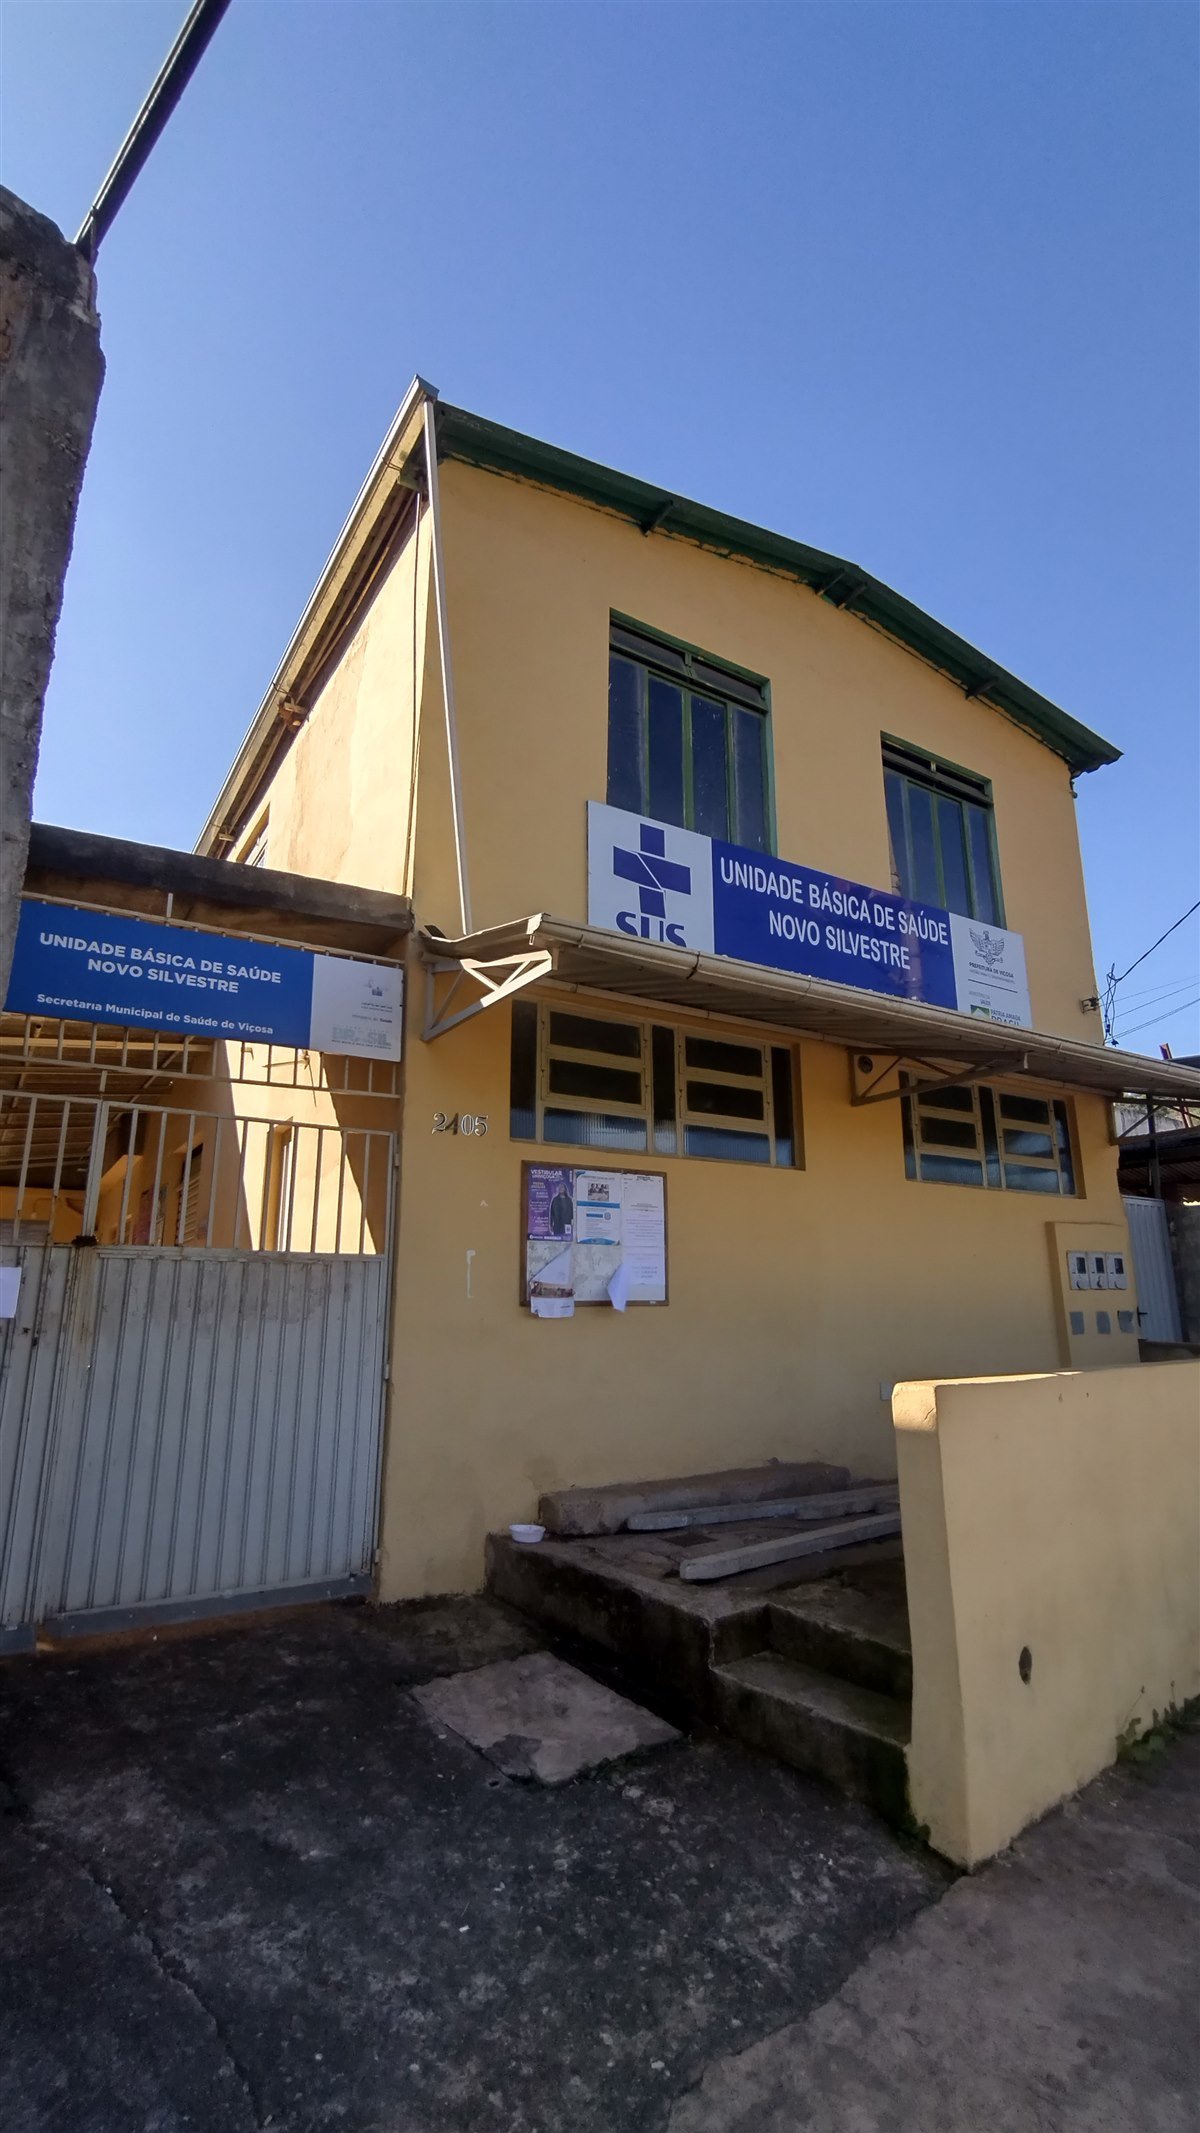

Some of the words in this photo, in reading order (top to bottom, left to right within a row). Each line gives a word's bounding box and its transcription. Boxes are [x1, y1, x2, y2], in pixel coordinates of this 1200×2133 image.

[720, 857, 804, 904] UNIDADE
[808, 882, 871, 924] BÁSICA
[873, 903, 895, 931] DE
[898, 910, 949, 945] SAÚDE
[40, 932, 126, 957] UNIDADE
[130, 948, 196, 969] BÁSICA
[200, 960, 223, 974] DE
[227, 965, 281, 983] SAÚDE
[769, 910, 820, 946] NOVO
[825, 925, 911, 970] SILVESTRE
[87, 958, 143, 977] NOVO
[147, 968, 239, 993] SILVESTRE
[37, 993, 102, 1011] Secretaria
[105, 1003, 163, 1019] Municipal
[166, 1012, 180, 1021] de
[183, 1015, 218, 1027] Saúde
[221, 1020, 235, 1029] de
[238, 1022, 274, 1034] Viçosa
